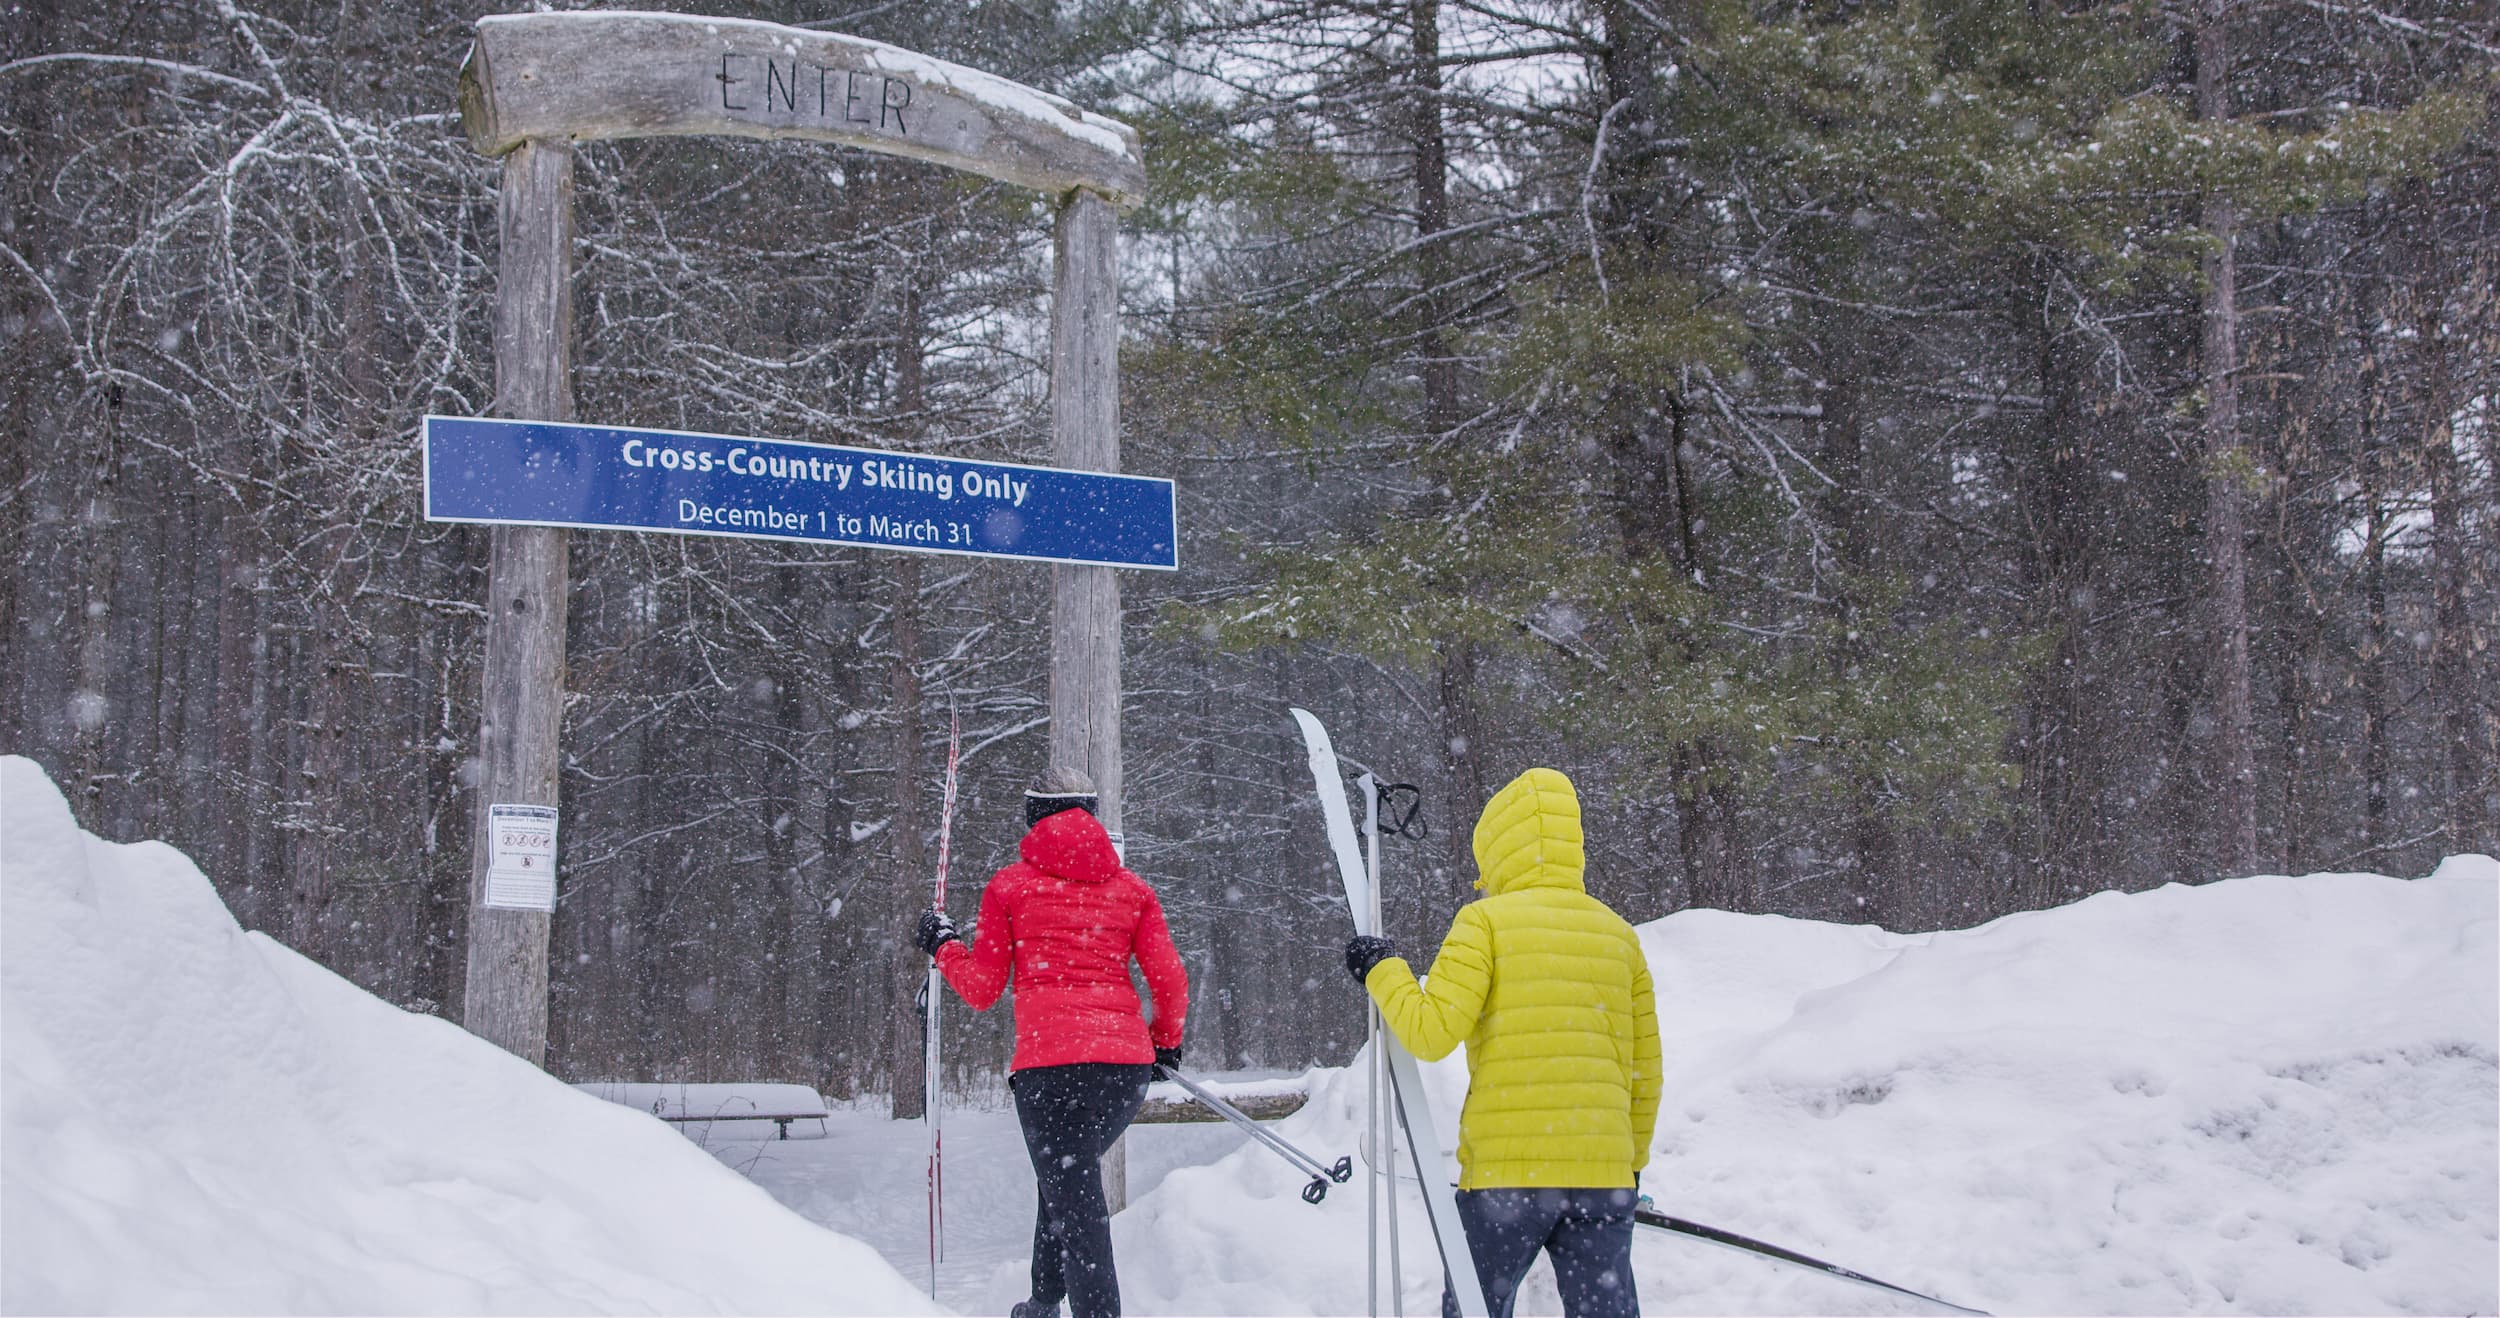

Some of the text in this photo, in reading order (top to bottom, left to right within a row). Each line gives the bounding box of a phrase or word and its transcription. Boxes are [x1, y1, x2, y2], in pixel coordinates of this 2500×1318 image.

[717, 53, 911, 134] ENTER
[622, 439, 1028, 507] Cross-Country Skiing Only
[679, 499, 971, 545] December 1 to March 31
